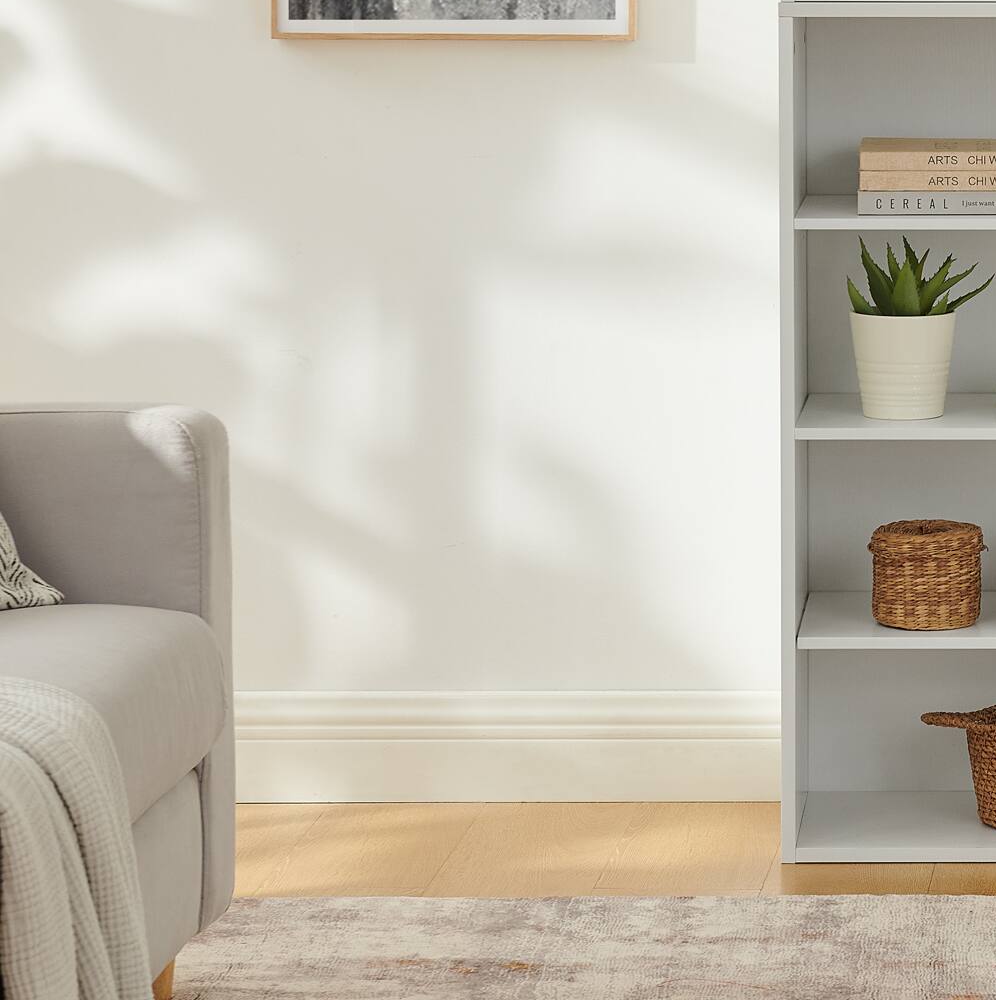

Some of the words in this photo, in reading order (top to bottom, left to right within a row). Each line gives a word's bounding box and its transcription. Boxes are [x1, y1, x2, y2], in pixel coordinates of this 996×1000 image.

[928, 156, 958, 165] ARTS
[968, 156, 986, 165] CHI
[928, 176, 959, 186] ARTS
[968, 176, 986, 186] CHI
[876, 198, 948, 209] CEREAL
